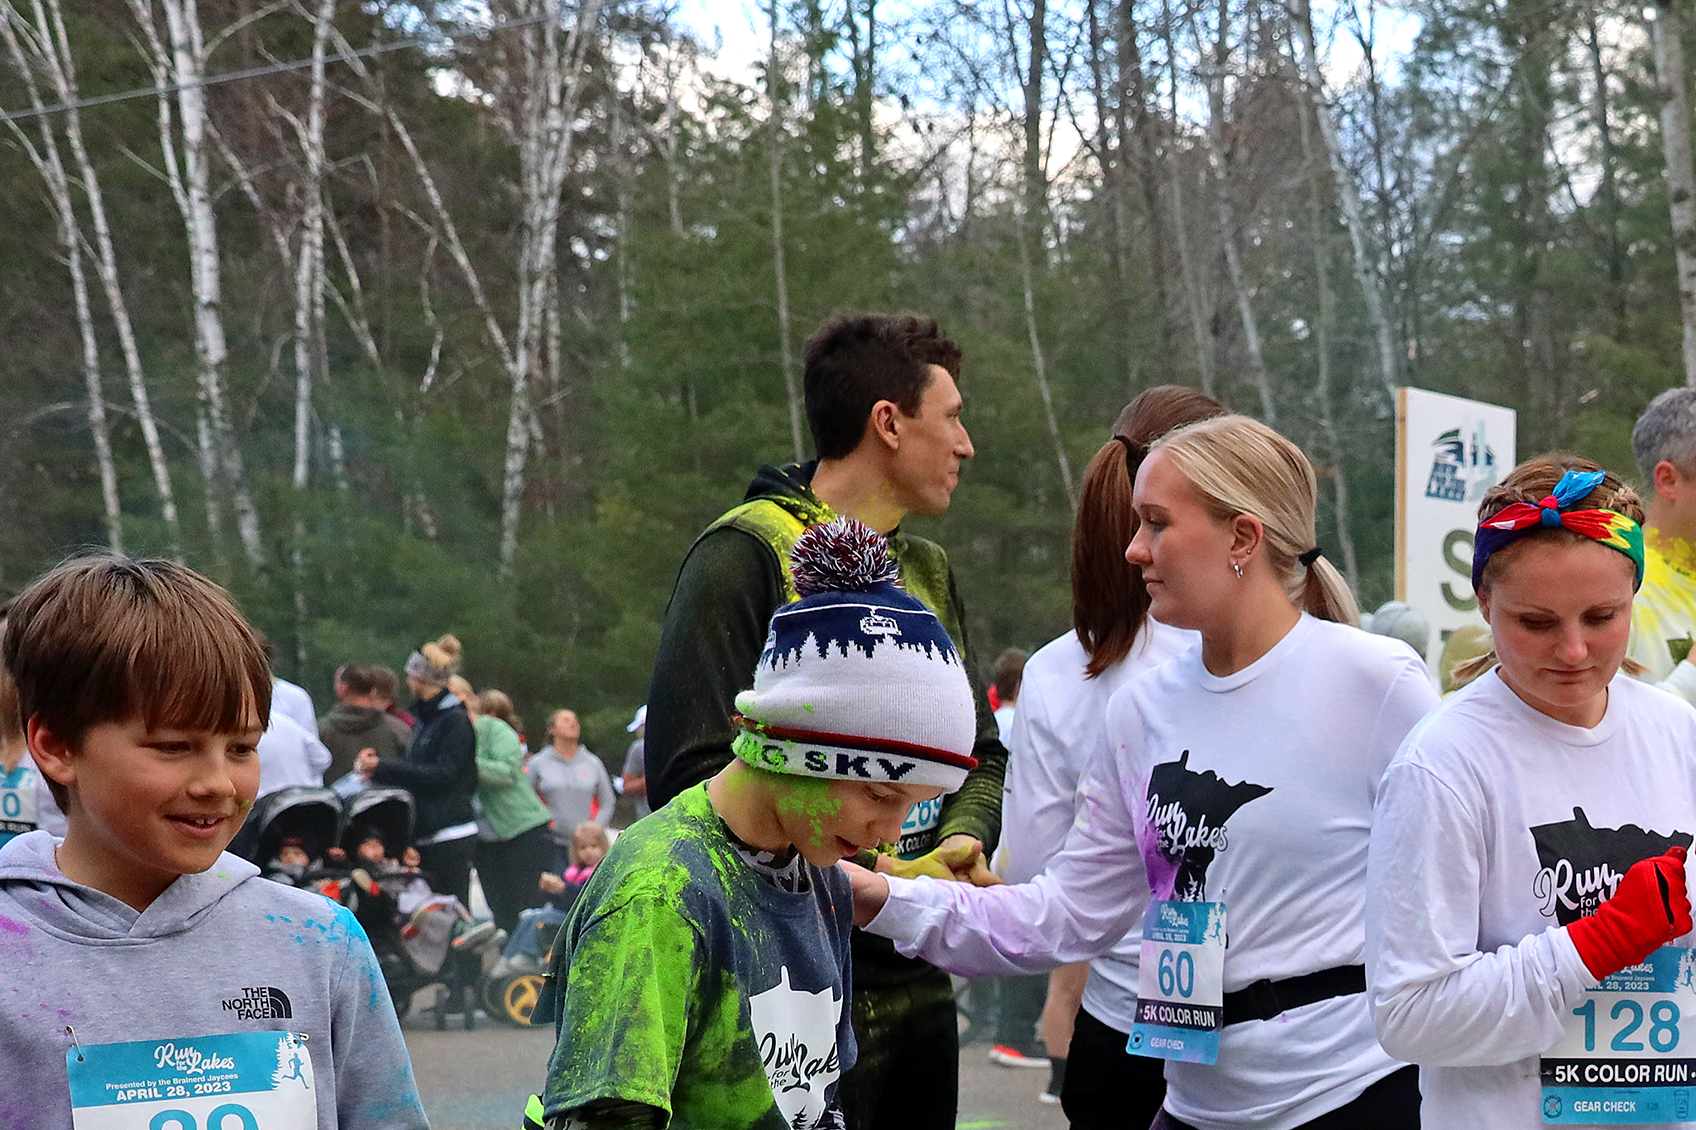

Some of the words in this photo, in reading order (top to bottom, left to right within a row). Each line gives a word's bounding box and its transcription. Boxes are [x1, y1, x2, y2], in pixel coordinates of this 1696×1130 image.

[804, 750, 916, 782] SKY
[1166, 807, 1229, 855] Lakes
[1533, 858, 1609, 917] Run
[1580, 896, 1598, 908] for
[1158, 949, 1195, 998] 60
[241, 987, 268, 998] THE
[1606, 981, 1622, 991] 28,
[1624, 982, 1650, 991] 2023
[222, 997, 269, 1011] NORTH
[237, 1008, 270, 1020] FACE
[1143, 1004, 1158, 1021] 5K
[1159, 1006, 1193, 1025] COLOR
[1193, 1010, 1216, 1028] RUN
[1572, 999, 1682, 1053] 128
[154, 1043, 196, 1069] Run
[186, 1051, 235, 1075] Lakes
[176, 1064, 188, 1072] the
[772, 1069, 790, 1080] for
[1555, 1064, 1580, 1084] 5K
[1584, 1064, 1652, 1083] COLOR
[1654, 1064, 1688, 1083] RUN
[105, 1081, 146, 1091] Presented
[147, 1079, 157, 1088] by
[158, 1078, 171, 1087] the
[173, 1075, 206, 1085] Brainerd
[207, 1073, 239, 1084] Jaycees
[116, 1087, 163, 1102] APRIL
[166, 1086, 191, 1098] 28,
[194, 1081, 232, 1094] 2023
[1574, 1101, 1602, 1112] GEAR
[1603, 1101, 1636, 1112] CHECK
